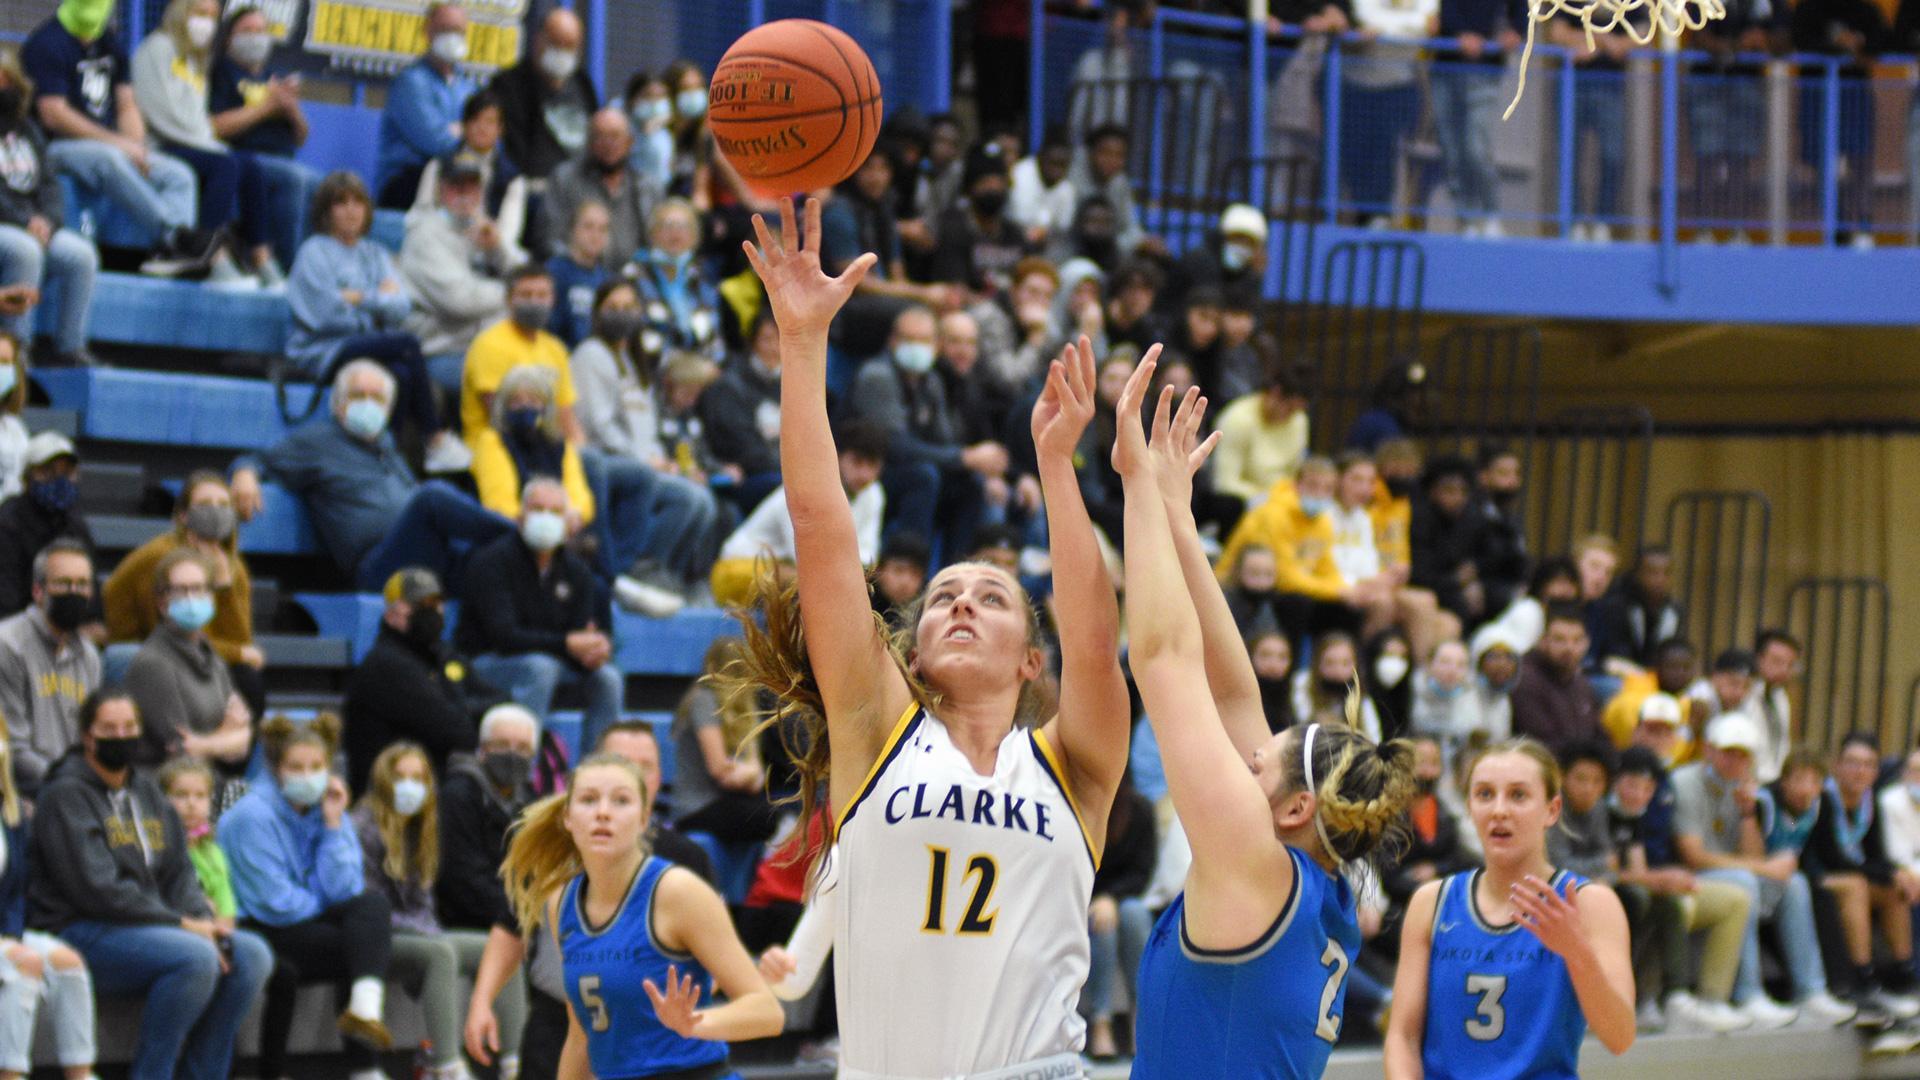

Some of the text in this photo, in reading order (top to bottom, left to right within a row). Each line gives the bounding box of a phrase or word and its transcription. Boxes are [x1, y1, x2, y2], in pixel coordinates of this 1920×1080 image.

[885, 783, 1054, 842] CLARKE
[920, 843, 1000, 936] 12
[579, 975, 610, 1032] 5
[1315, 937, 1349, 1043] 2
[1465, 973, 1507, 1040] 3
